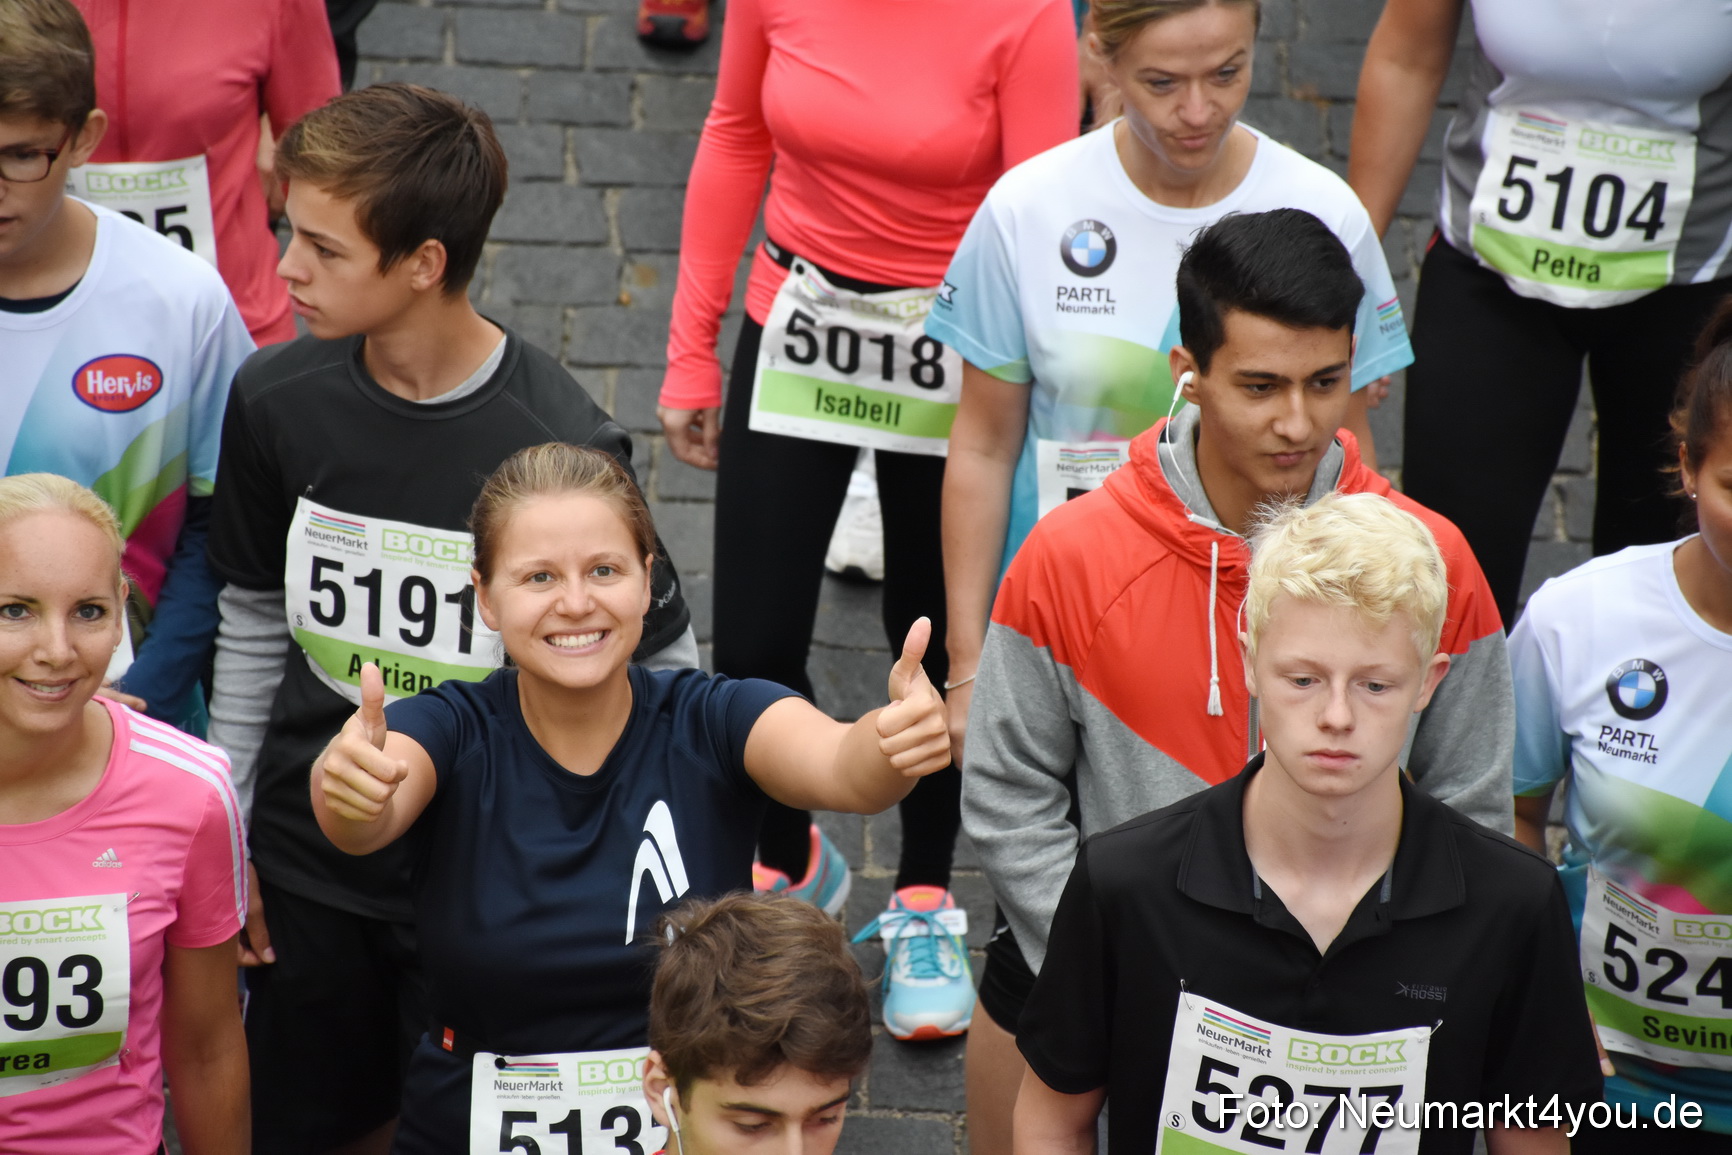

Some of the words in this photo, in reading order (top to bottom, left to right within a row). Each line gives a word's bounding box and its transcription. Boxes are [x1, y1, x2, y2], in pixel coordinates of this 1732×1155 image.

[1577, 128, 1677, 162] BOCK
[85, 167, 189, 193] BOCK
[1498, 155, 1668, 241] 5104
[1066, 220, 1114, 241] BMW
[1531, 249, 1601, 283] Petra
[1056, 286, 1116, 303] PARTL
[1056, 302, 1116, 315] Neumarkt
[784, 308, 945, 390] 5018
[86, 369, 153, 398] Hervis
[814, 387, 901, 428] Isabell
[304, 526, 368, 551] NeuerMarkt
[381, 552, 413, 563] inspired
[415, 557, 424, 567] by
[426, 560, 449, 570] smart
[309, 555, 477, 655] 5191
[296, 614, 304, 627] S
[348, 653, 433, 693] Arian
[1612, 659, 1665, 682] BMW
[1599, 725, 1659, 751] PARTL
[1597, 741, 1657, 764] Neumarkt
[92, 860, 122, 868] adidas
[1603, 894, 1660, 935] NeuerMarkt
[21, 936, 32, 946] by
[35, 935, 63, 945] smart
[65, 932, 107, 943] concepts
[1588, 971, 1596, 984] S
[1603, 922, 1732, 1009] 524
[2, 954, 104, 1031] 93
[1410, 989, 1447, 1003] ROSSI
[1197, 1023, 1272, 1058] NeuerMarkt
[1643, 1015, 1732, 1050] Sevin
[0, 1052, 51, 1071] rea
[1287, 1038, 1408, 1066] BOCK
[1285, 1061, 1326, 1074] inspired
[1326, 1065, 1338, 1076] by
[1340, 1066, 1367, 1075] smart
[1368, 1064, 1408, 1075] concepts
[494, 1079, 563, 1092] NeuerMarkt
[578, 1087, 614, 1097] inspired
[616, 1085, 627, 1094] by
[1191, 1055, 1404, 1155] 5277
[499, 1105, 668, 1155] 513
[1171, 1114, 1180, 1128] S
